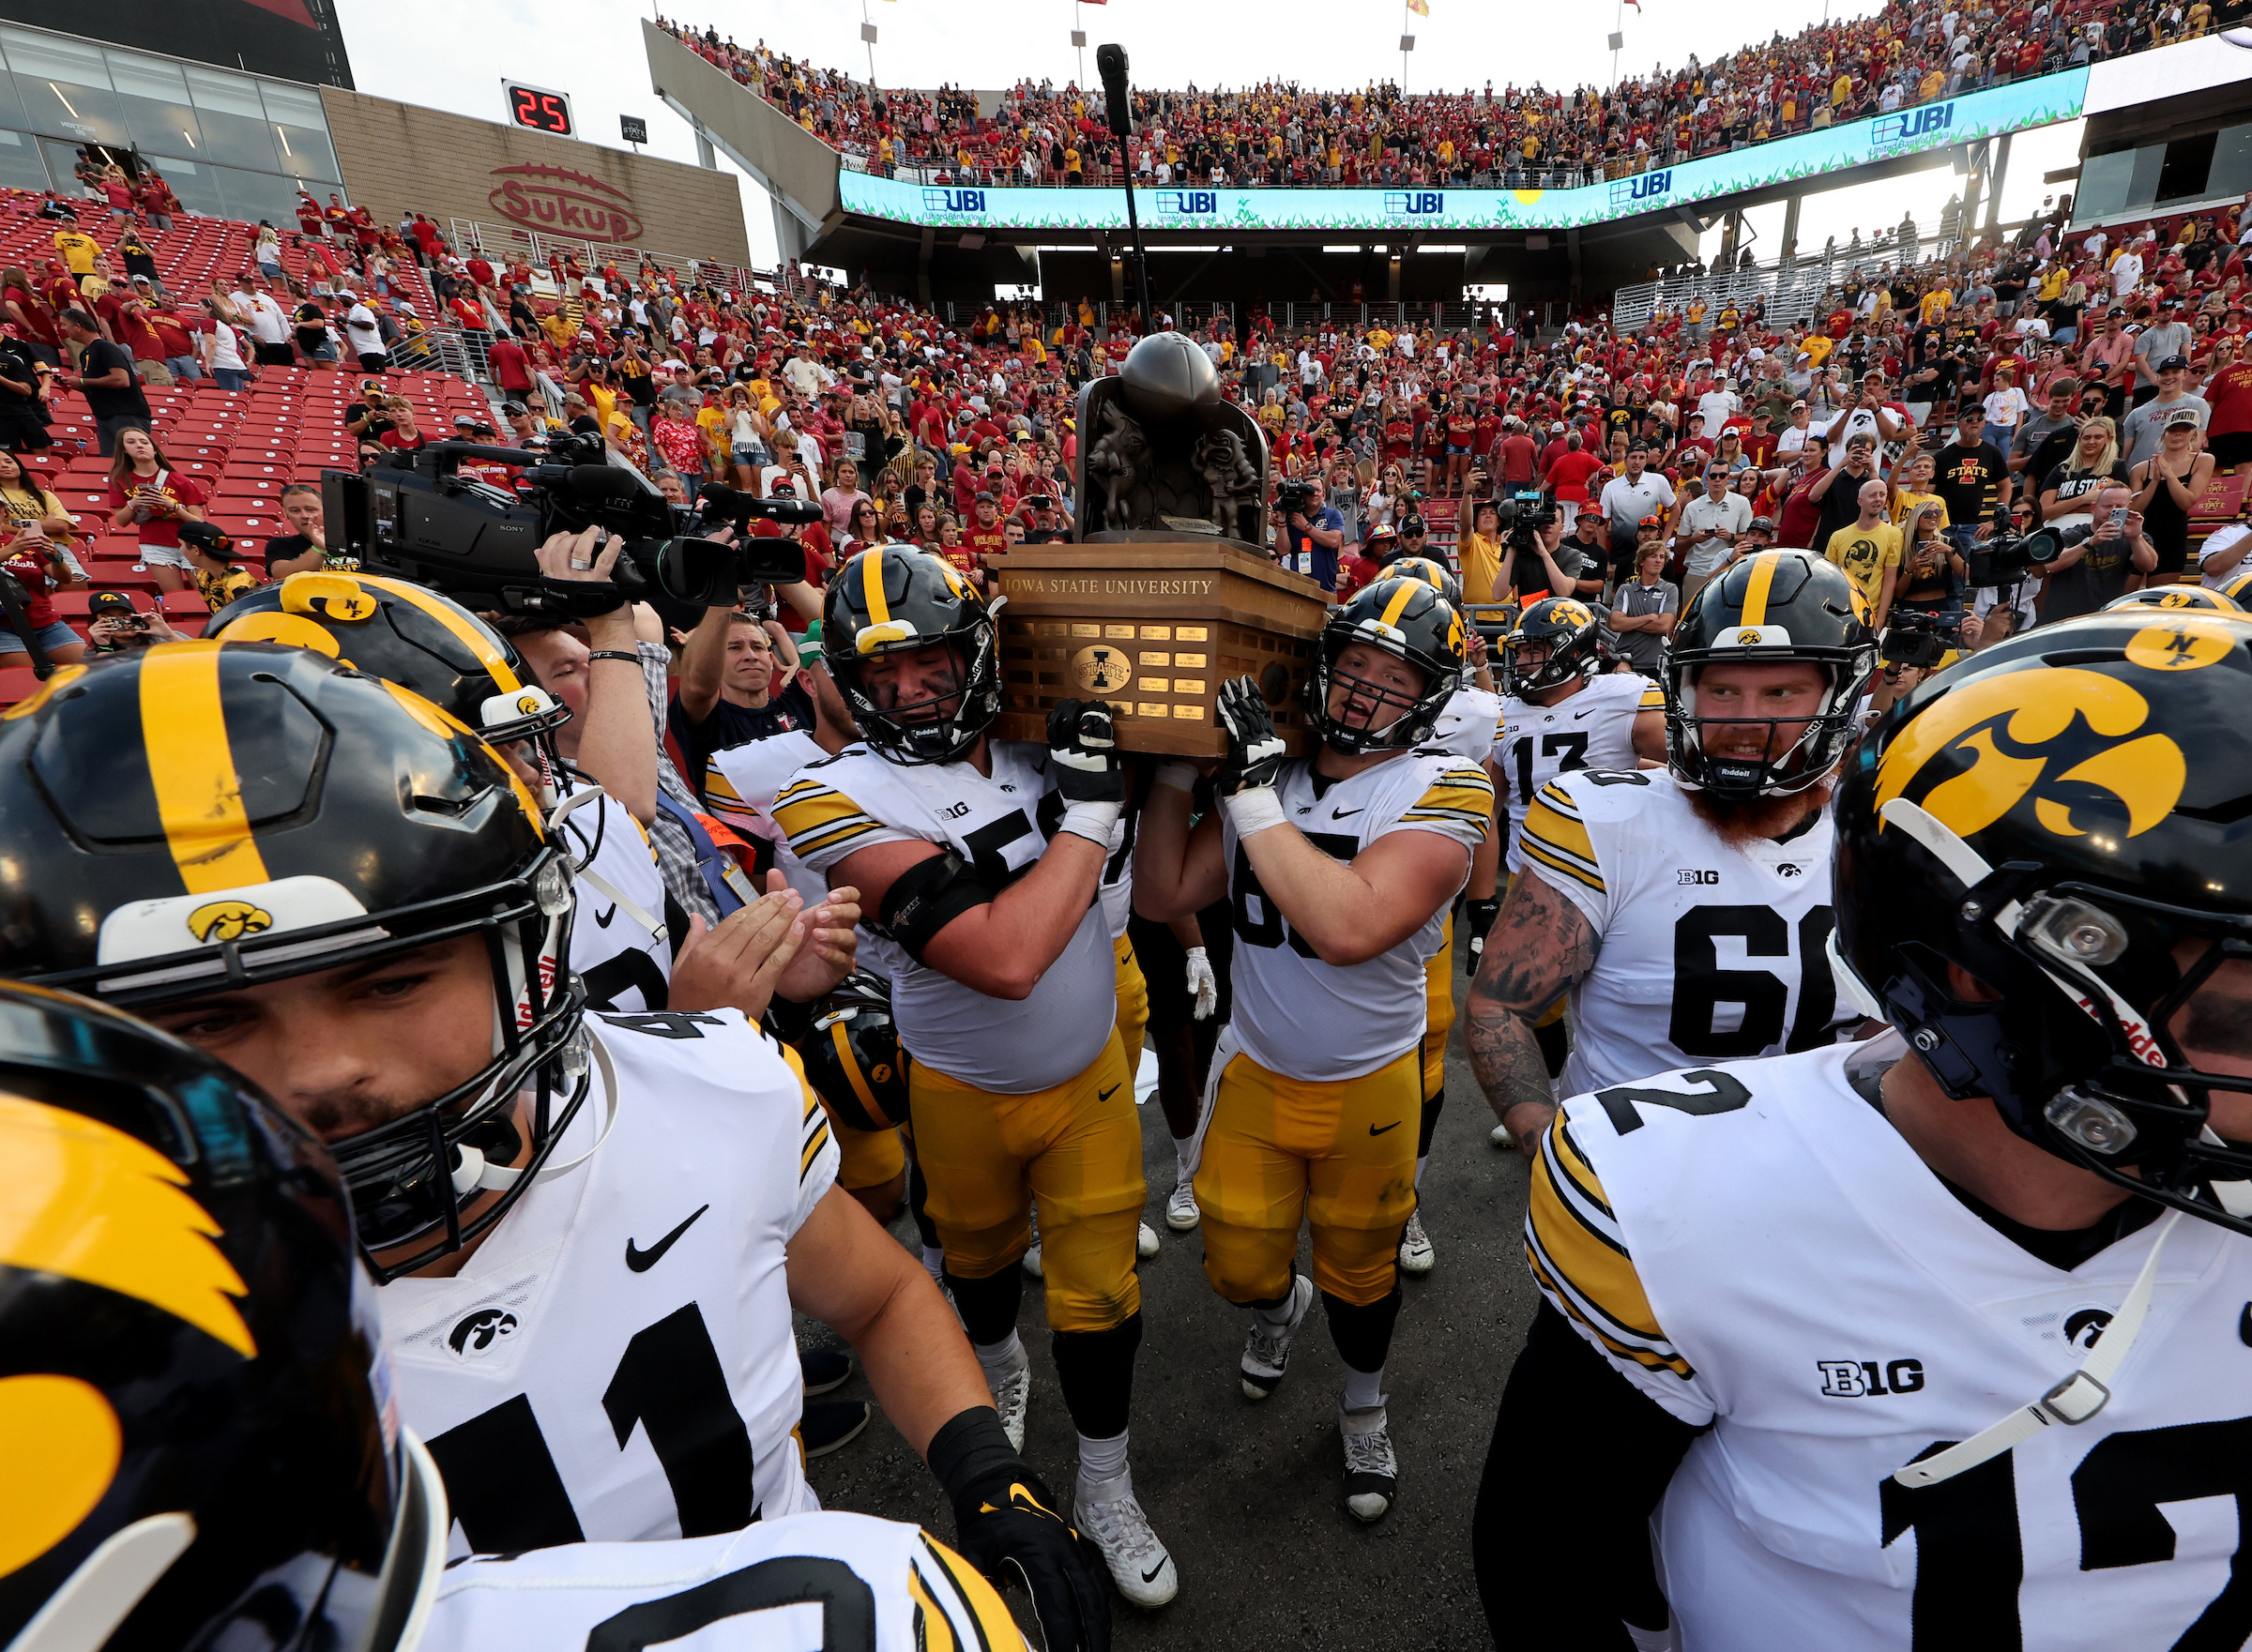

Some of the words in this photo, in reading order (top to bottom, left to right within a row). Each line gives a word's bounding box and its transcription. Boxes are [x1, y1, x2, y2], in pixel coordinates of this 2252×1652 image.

[517, 89, 566, 131] 25
[1900, 102, 1954, 138] UBI
[1869, 144, 1897, 156] United
[1631, 171, 1672, 199] UBI
[945, 189, 985, 212] UBI
[1179, 192, 1217, 214] UBI
[1407, 192, 1443, 214] UBI
[502, 180, 629, 242] Sukup
[925, 212, 948, 220] United
[1158, 215, 1179, 223] United
[1384, 215, 1405, 223] United
[1947, 466, 1988, 479] STATE
[499, 524, 525, 533] SONY
[1005, 579, 1044, 593] IOWA
[1050, 579, 1099, 594] STATE
[1105, 580, 1213, 595] UNIVERSITY
[1079, 660, 1124, 682] STATE
[915, 728, 939, 737] Riddell
[1721, 767, 1750, 778] Riddell
